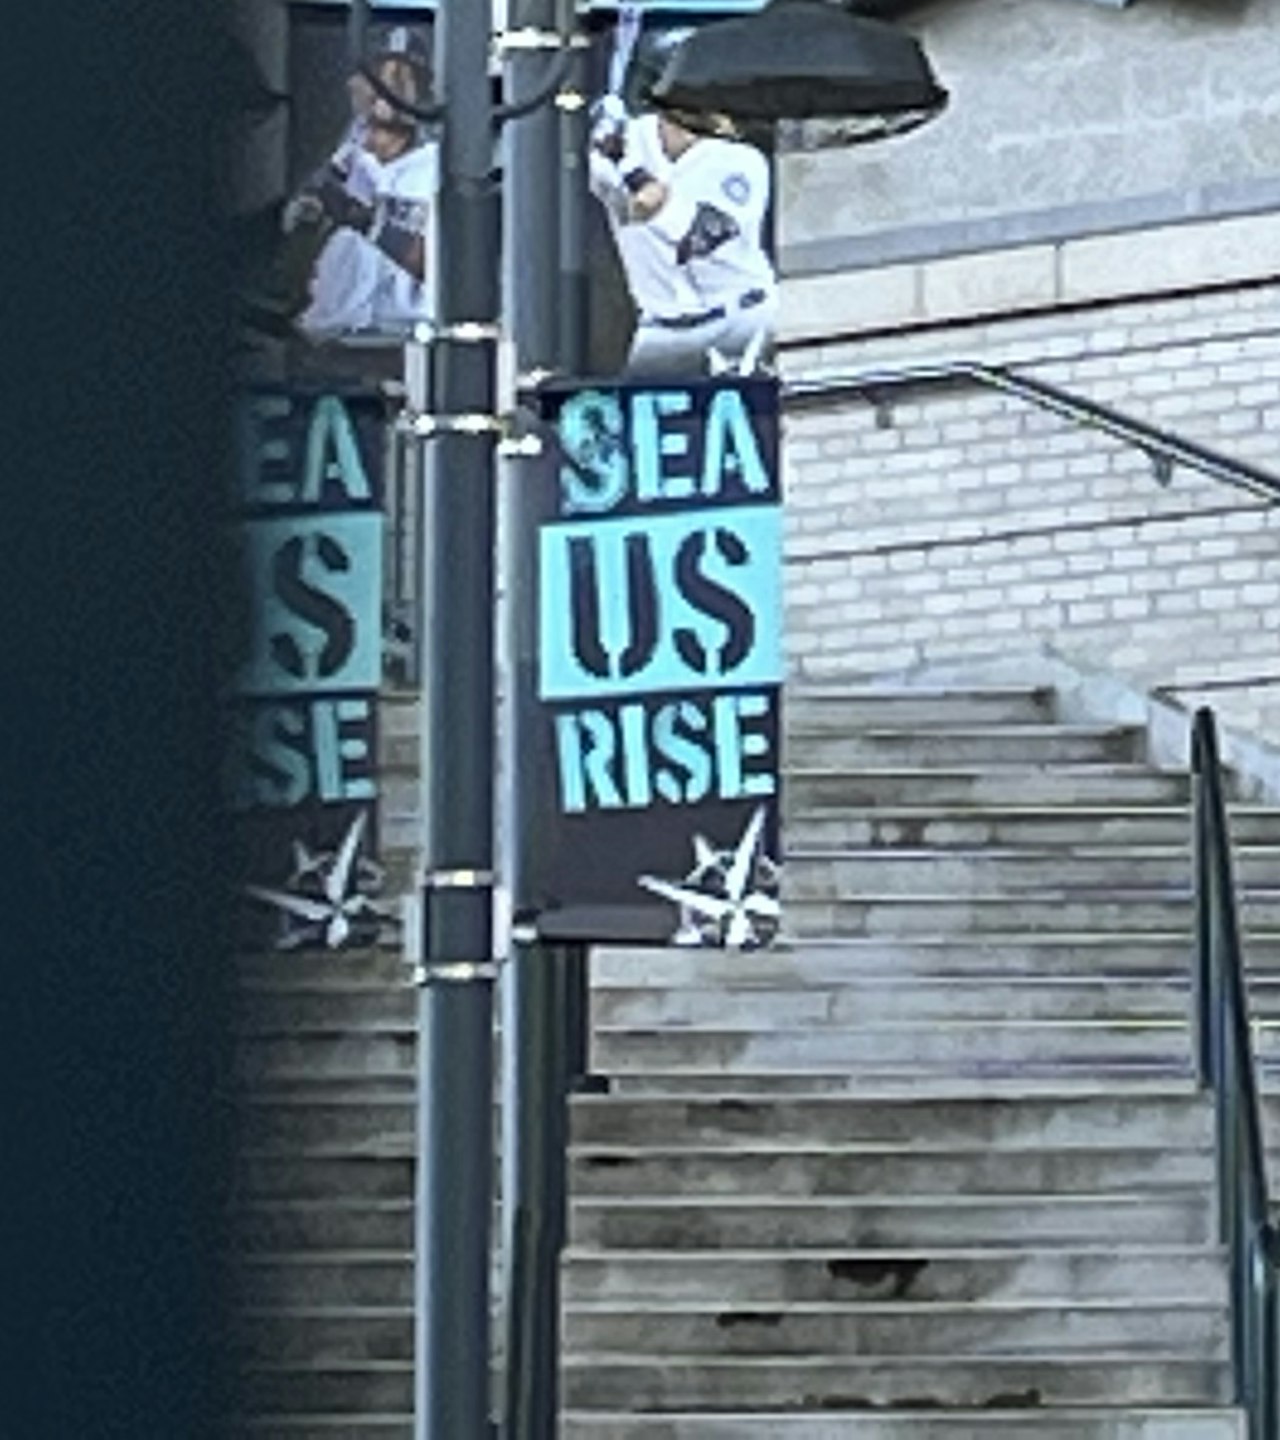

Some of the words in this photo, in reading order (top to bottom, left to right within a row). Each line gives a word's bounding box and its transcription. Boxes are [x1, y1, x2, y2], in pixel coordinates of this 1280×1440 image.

[246, 393, 373, 505] EA
[558, 390, 770, 513] SEA
[269, 532, 356, 678] S
[566, 527, 757, 679] US
[556, 695, 776, 812] RISE
